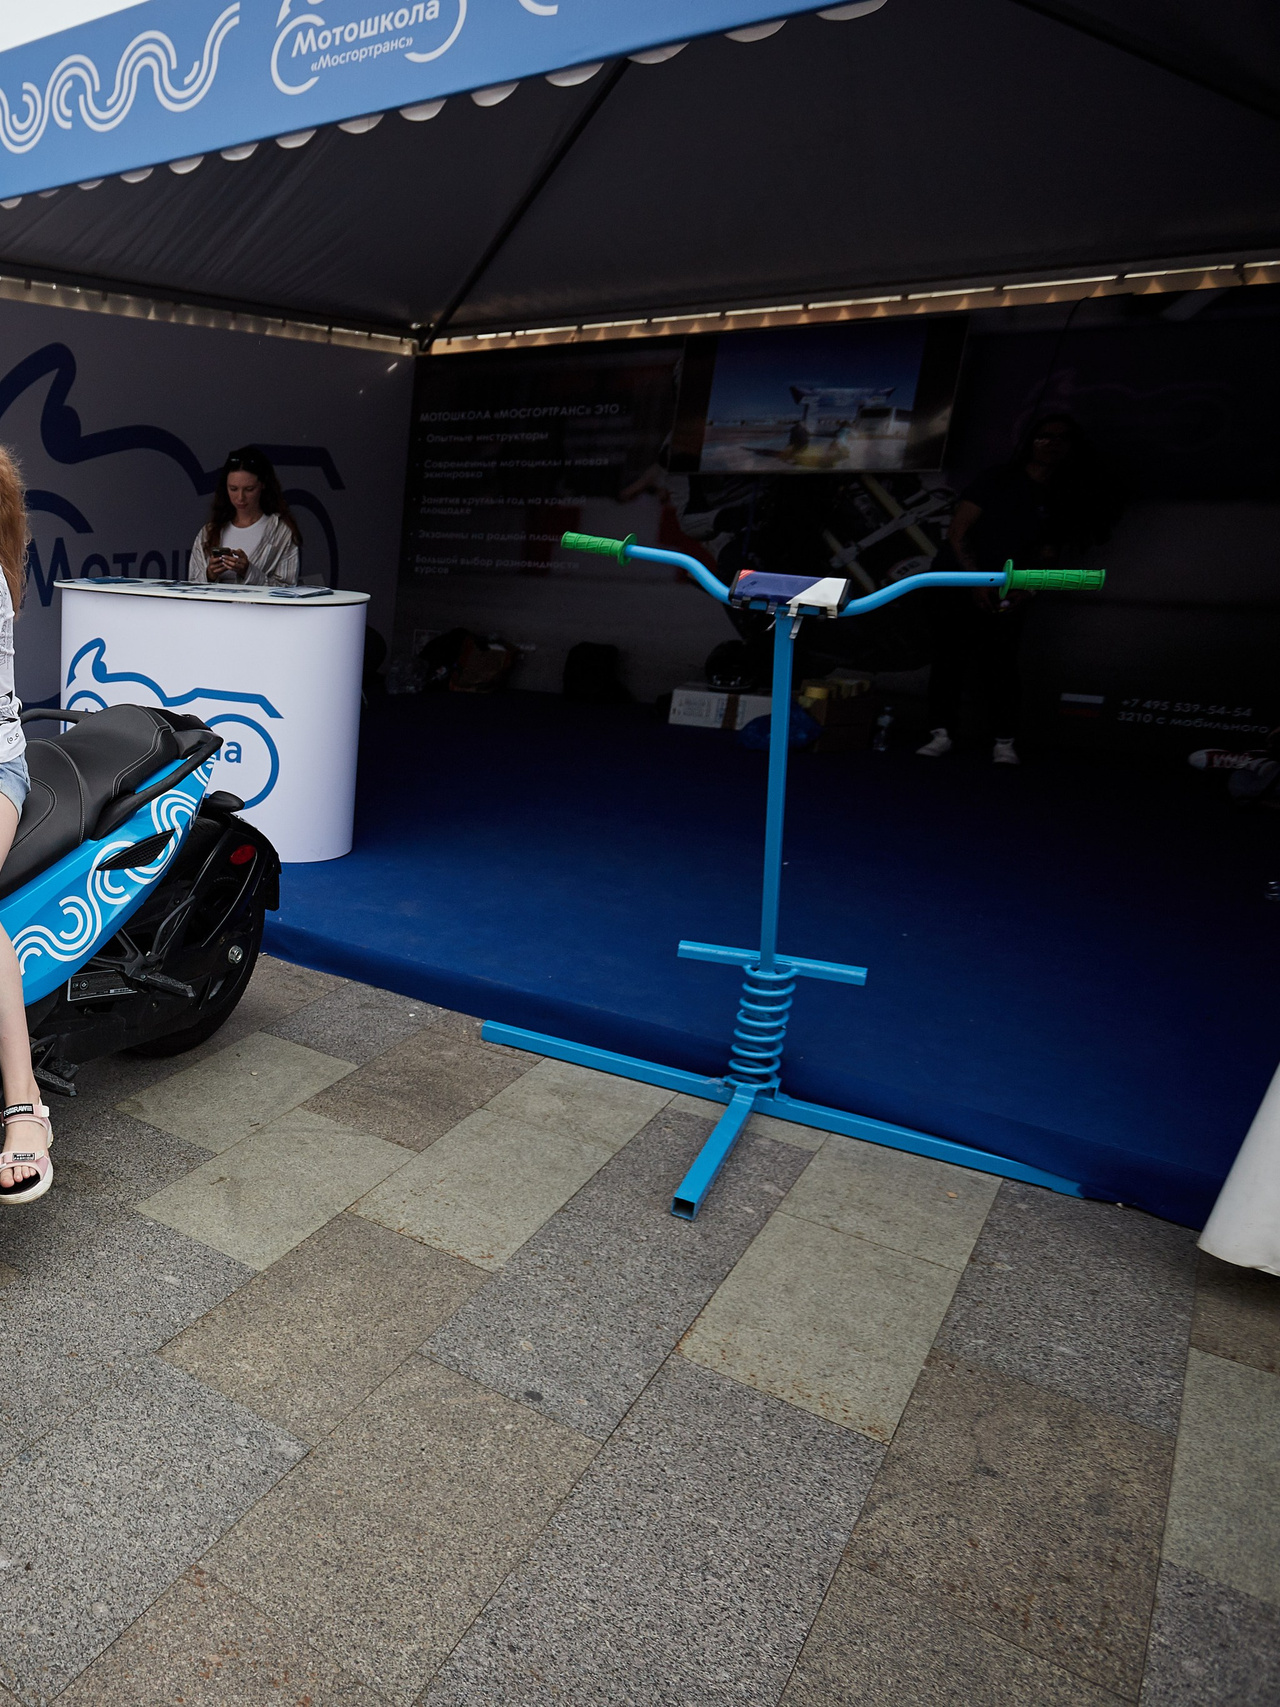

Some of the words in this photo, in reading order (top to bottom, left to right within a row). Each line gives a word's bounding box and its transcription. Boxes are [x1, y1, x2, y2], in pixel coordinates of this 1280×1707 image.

[291, 0, 441, 58] Мотошкола
[310, 36, 413, 72] «Мосгортранс»
[419, 409, 491, 423] МОТОШКОЛА
[493, 404, 592, 421] «МОСГОРТРАНС»
